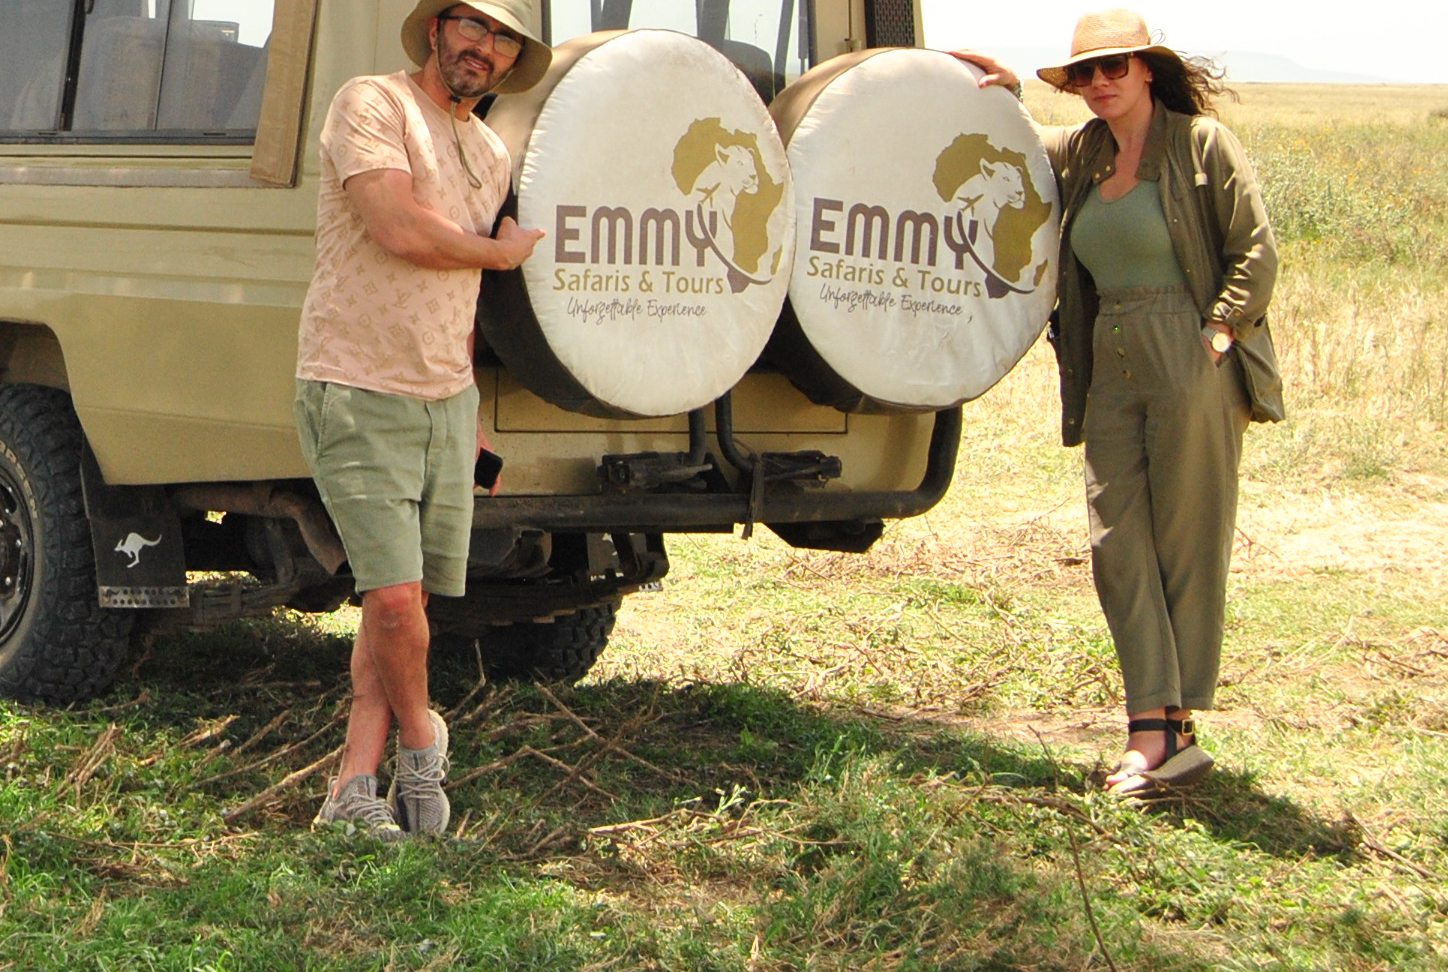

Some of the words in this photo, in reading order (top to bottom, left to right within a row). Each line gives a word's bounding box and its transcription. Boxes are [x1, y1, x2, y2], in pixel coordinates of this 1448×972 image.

[553, 268, 630, 293] Safaris
[638, 270, 654, 293] &
[662, 271, 724, 295] Tours
[806, 255, 885, 285] Safaris
[892, 267, 909, 289] &
[917, 269, 981, 298] Tours
[566, 296, 643, 325] Unforgettable
[647, 299, 707, 323] Experience
[819, 283, 896, 313] Unforgettable
[901, 294, 964, 318] Experience
